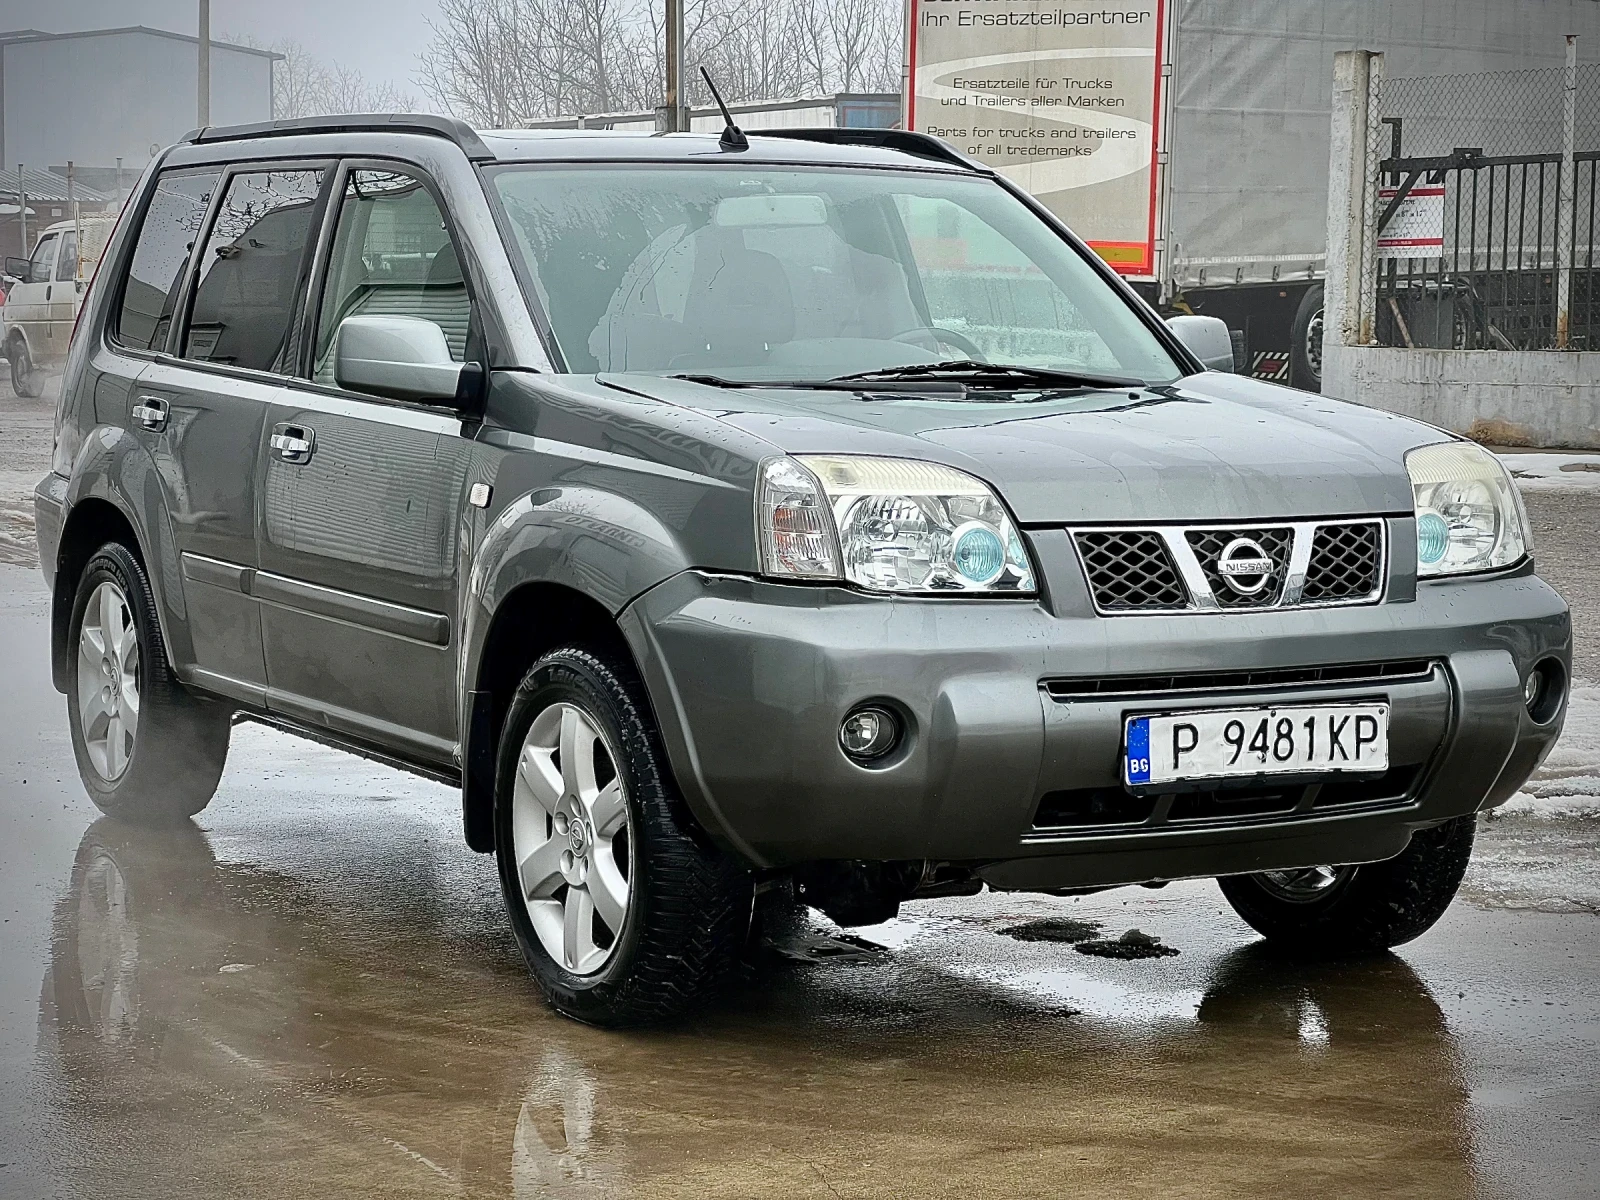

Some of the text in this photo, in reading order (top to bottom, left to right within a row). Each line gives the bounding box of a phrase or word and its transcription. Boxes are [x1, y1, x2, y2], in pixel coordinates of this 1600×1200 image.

[921, 9, 1150, 28] Ihr Ersatzteilpartner
[953, 78, 1113, 89] Ersatzteile für Trucks
[941, 96, 1125, 107] und Trailers aller Marken
[927, 127, 1136, 139] Parts for trucks and trailers
[967, 145, 1092, 156] of all trademarks
[1225, 562, 1272, 572] NISSAN
[1172, 723, 1199, 770] P
[1131, 758, 1148, 773] BG
